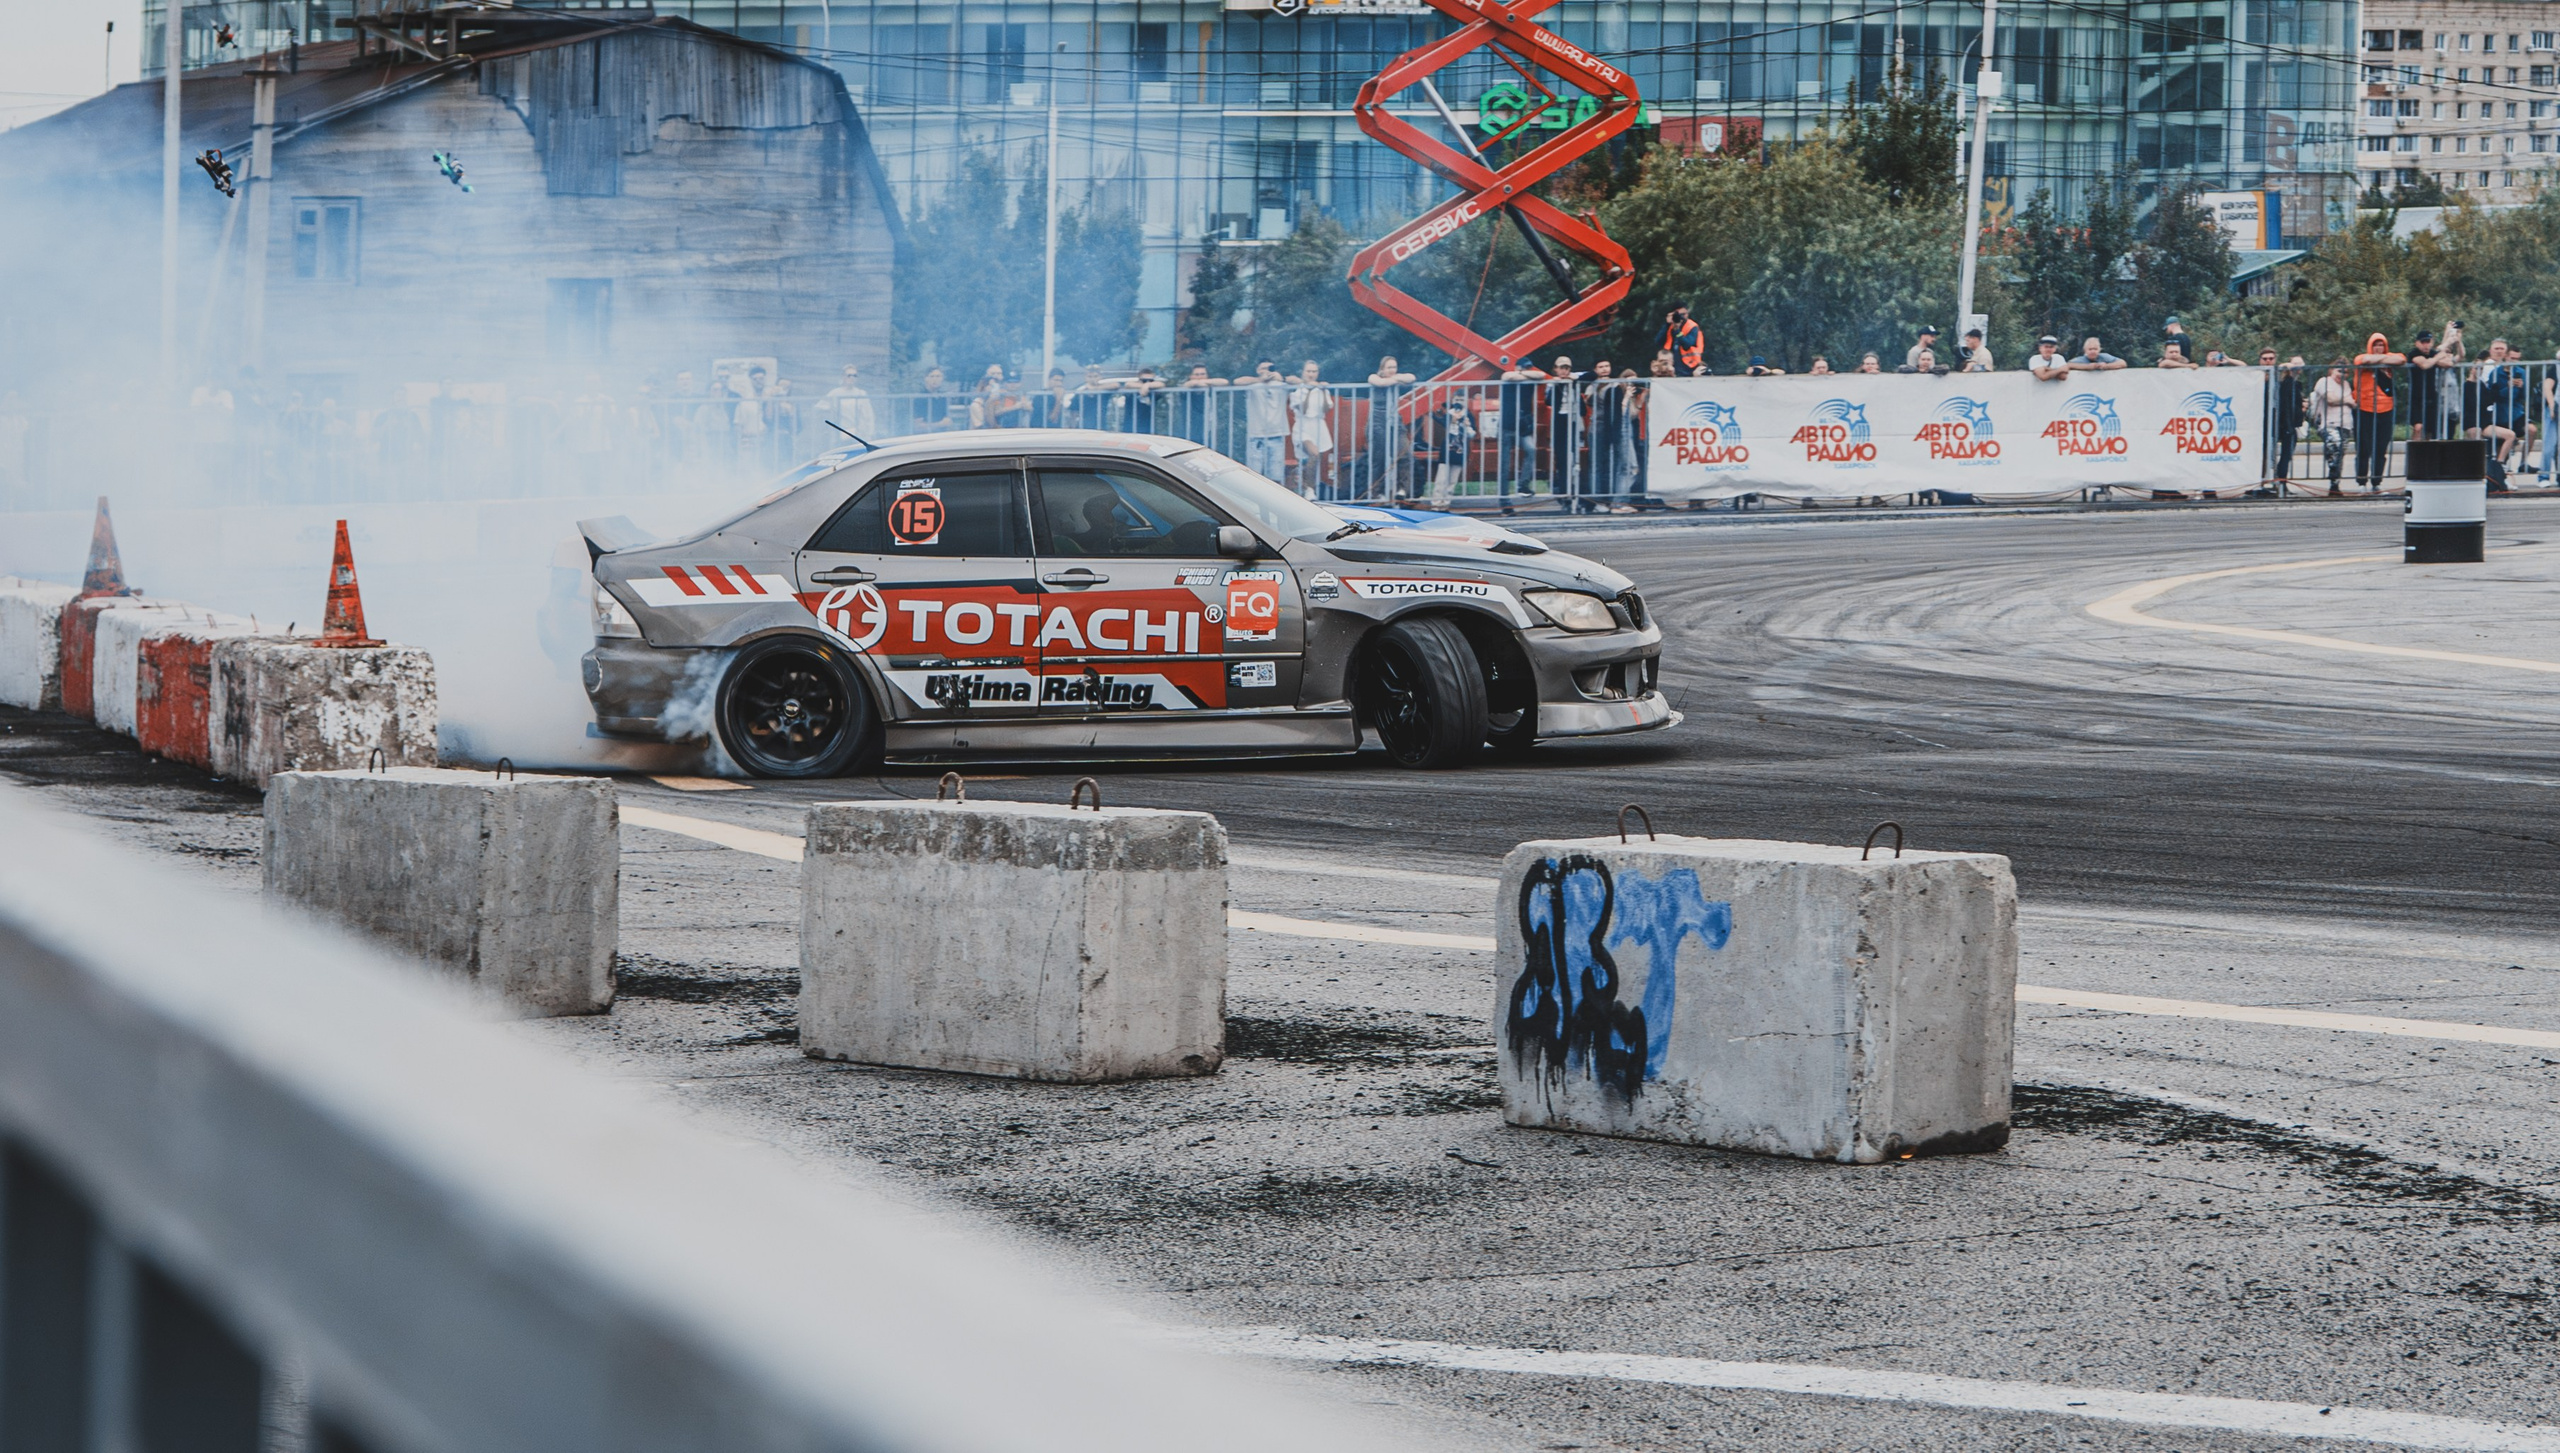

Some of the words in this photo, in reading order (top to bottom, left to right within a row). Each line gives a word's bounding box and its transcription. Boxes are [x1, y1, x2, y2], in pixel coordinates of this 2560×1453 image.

[1391, 201, 1481, 262] СЕРВИС
[1789, 425, 1847, 444] АВТО
[1913, 422, 1969, 441] АВТО
[2040, 419, 2097, 438] АВТО
[2159, 417, 2213, 436] АВТО
[1658, 427, 1717, 447] АВТО
[2057, 436, 2128, 456] РАДИО
[2176, 435, 2242, 453] РАДИО
[1676, 445, 1750, 465] РАДИО
[1806, 442, 1877, 462] РАДИО
[1930, 440, 2001, 460] РАДИО
[899, 501, 936, 533] 15
[1182, 576, 1214, 585] AUTO
[1367, 583, 1488, 596] TOTACHI.RU
[1230, 592, 1275, 617] FQ
[899, 600, 1200, 653] TOTACHI
[924, 674, 1032, 702] Ultima
[1042, 675, 1155, 711] Racing
